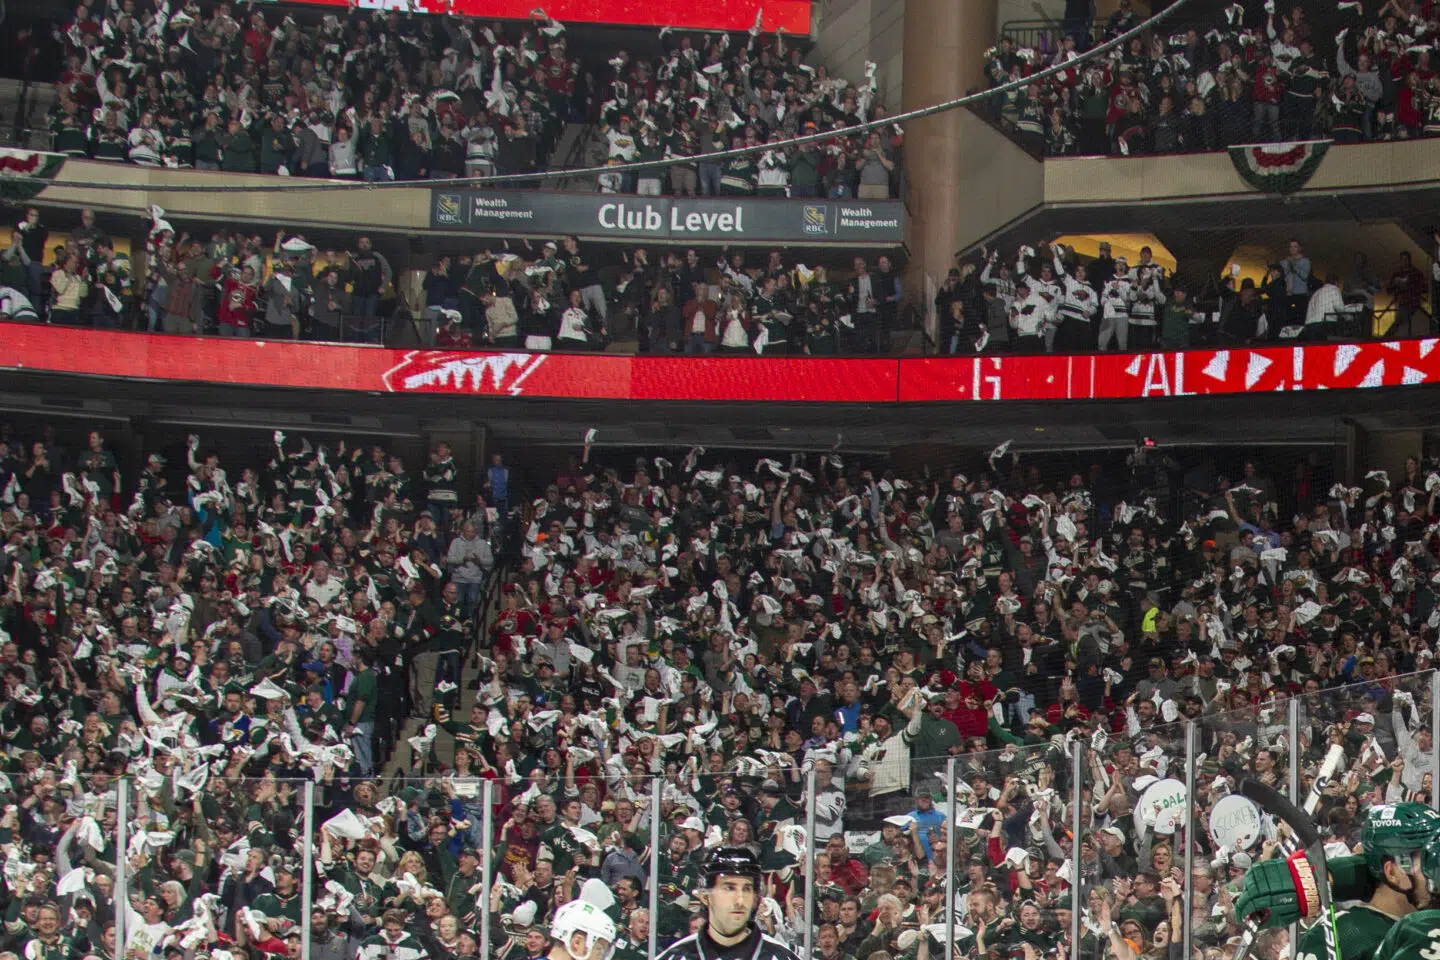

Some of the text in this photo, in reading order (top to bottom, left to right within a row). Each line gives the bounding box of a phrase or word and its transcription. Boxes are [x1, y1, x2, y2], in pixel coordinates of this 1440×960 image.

[475, 197, 507, 208] Wealth
[475, 208, 533, 219] Management
[599, 203, 743, 232] Club Level
[840, 207, 873, 218] Wealth
[439, 214, 457, 222] RBC
[840, 218, 898, 228] Management
[805, 224, 824, 232] RBC
[1372, 819, 1402, 828] TOYOTA
